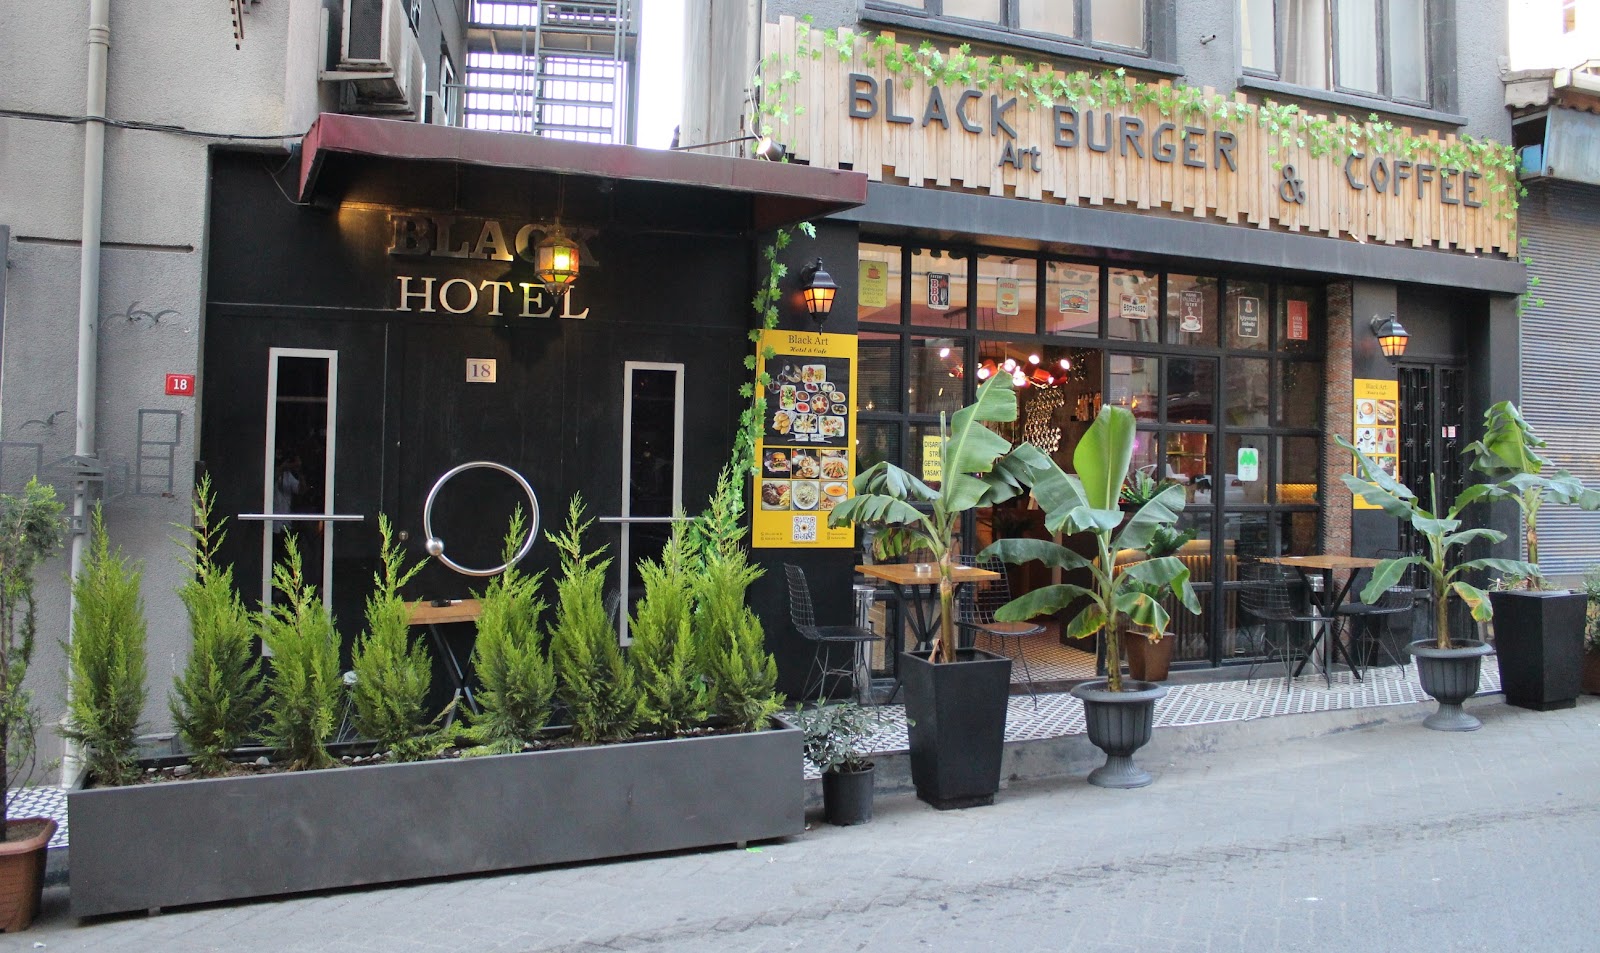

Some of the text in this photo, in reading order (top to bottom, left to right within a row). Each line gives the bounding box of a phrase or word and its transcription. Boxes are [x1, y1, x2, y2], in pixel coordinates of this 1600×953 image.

[848, 72, 1483, 209] BLACK BURGER & COFFEE
[999, 140, 1042, 173] Art
[396, 275, 590, 320] HOTEL
[788, 334, 829, 346] Black Art
[472, 363, 491, 378] 18
[173, 378, 188, 391] 18
